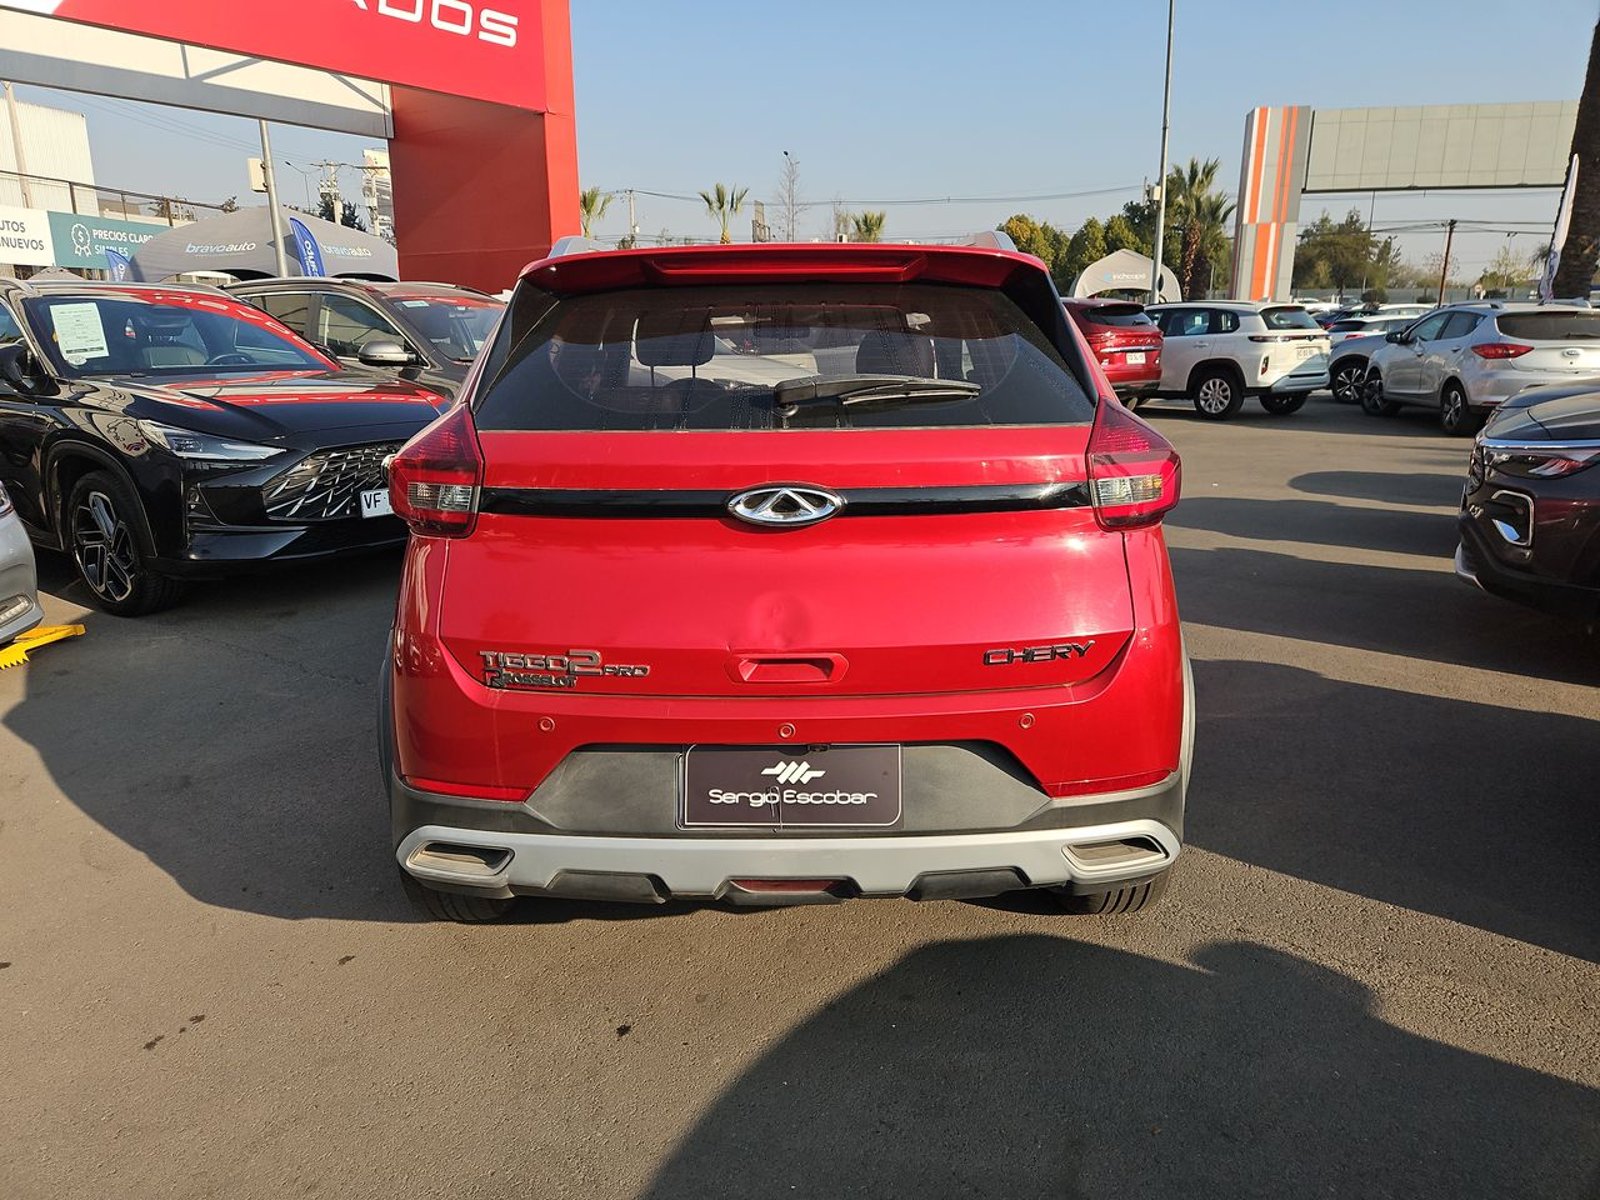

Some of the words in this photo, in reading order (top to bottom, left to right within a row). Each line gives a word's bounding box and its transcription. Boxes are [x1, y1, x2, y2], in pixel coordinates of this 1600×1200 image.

[353, 0, 519, 47] DOS
[0, 236, 45, 251] NUEVOS
[92, 229, 127, 242] PRECIOS
[185, 242, 257, 254] bravoauto
[983, 639, 1096, 666] CHERY
[708, 789, 780, 808] Sergio
[783, 789, 878, 805] Escobar
